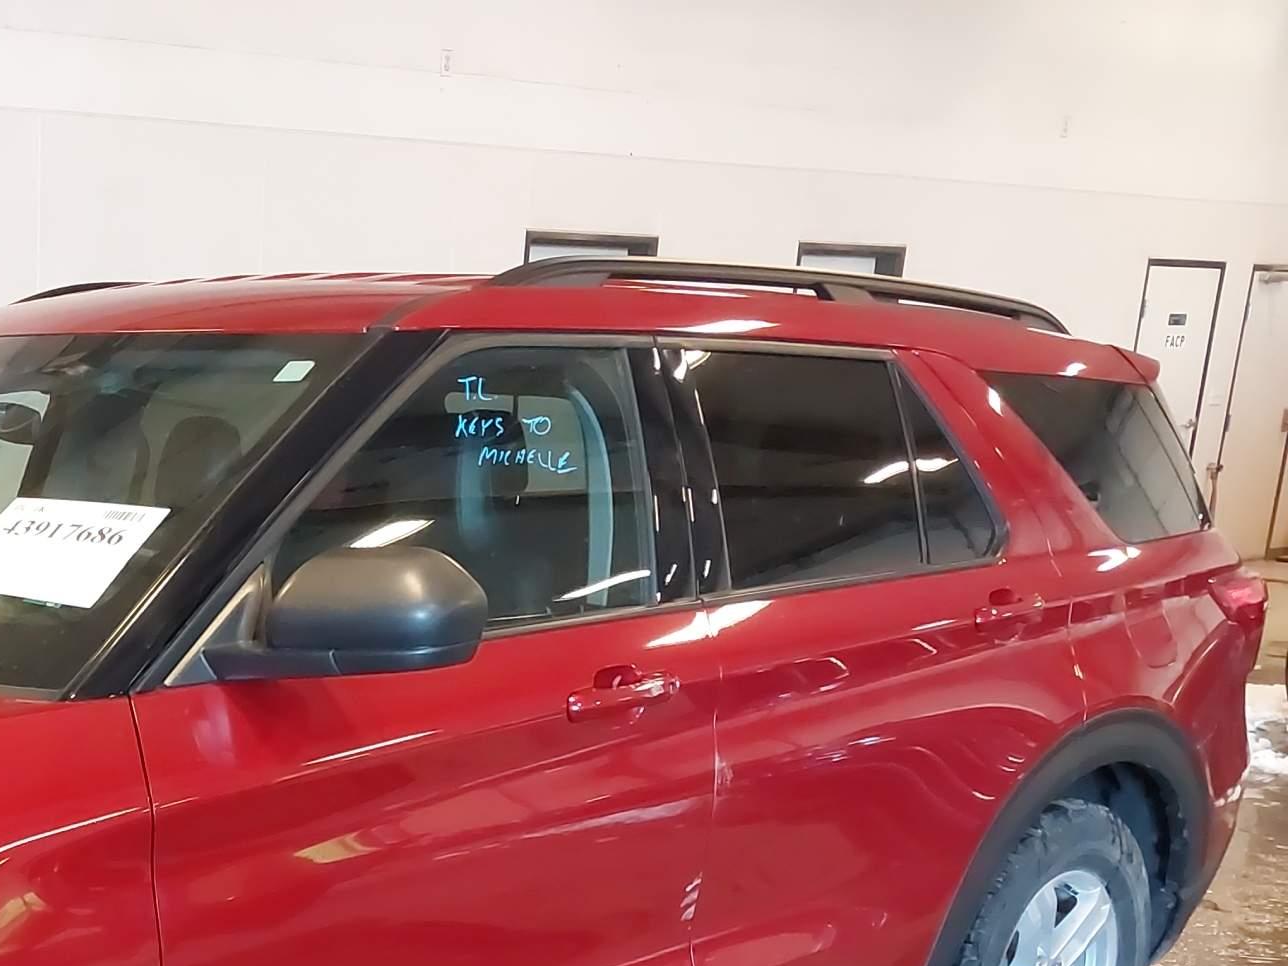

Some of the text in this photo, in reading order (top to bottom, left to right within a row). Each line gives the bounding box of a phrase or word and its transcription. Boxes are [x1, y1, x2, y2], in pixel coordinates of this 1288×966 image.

[1164, 335, 1186, 348] FACP
[454, 413, 552, 438] KEYS TO
[477, 445, 578, 475] MICHELLE
[2, 518, 129, 546] 43917686
